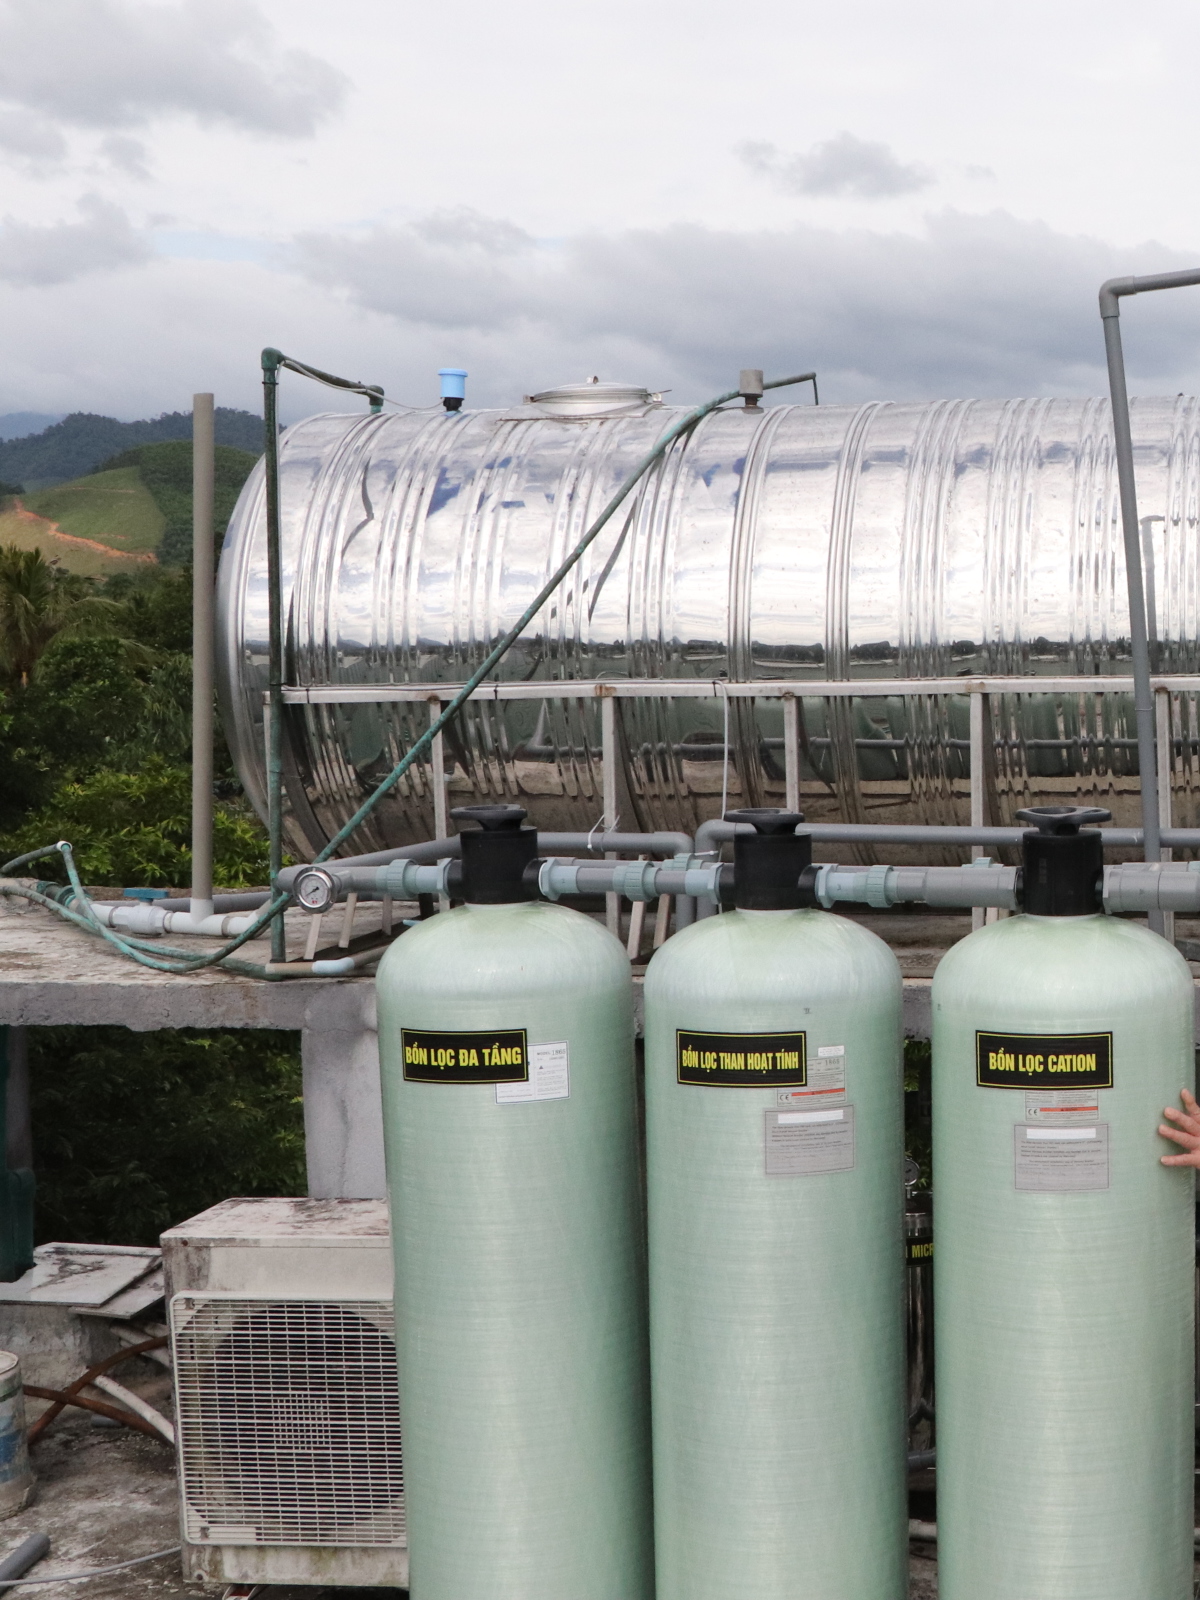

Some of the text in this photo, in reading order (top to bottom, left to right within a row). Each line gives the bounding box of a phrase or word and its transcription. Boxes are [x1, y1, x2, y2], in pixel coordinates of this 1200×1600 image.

[405, 1041, 522, 1070] BỒN LỌC ĐA TẦNG
[682, 1045, 698, 1068] BỒN
[700, 1051, 717, 1072] LỌC
[719, 1052, 745, 1070] THAN
[747, 1052, 773, 1074] HOẠT
[775, 1048, 799, 1070] TÍNH
[989, 1047, 1096, 1076] BỒN LỌC CATION
